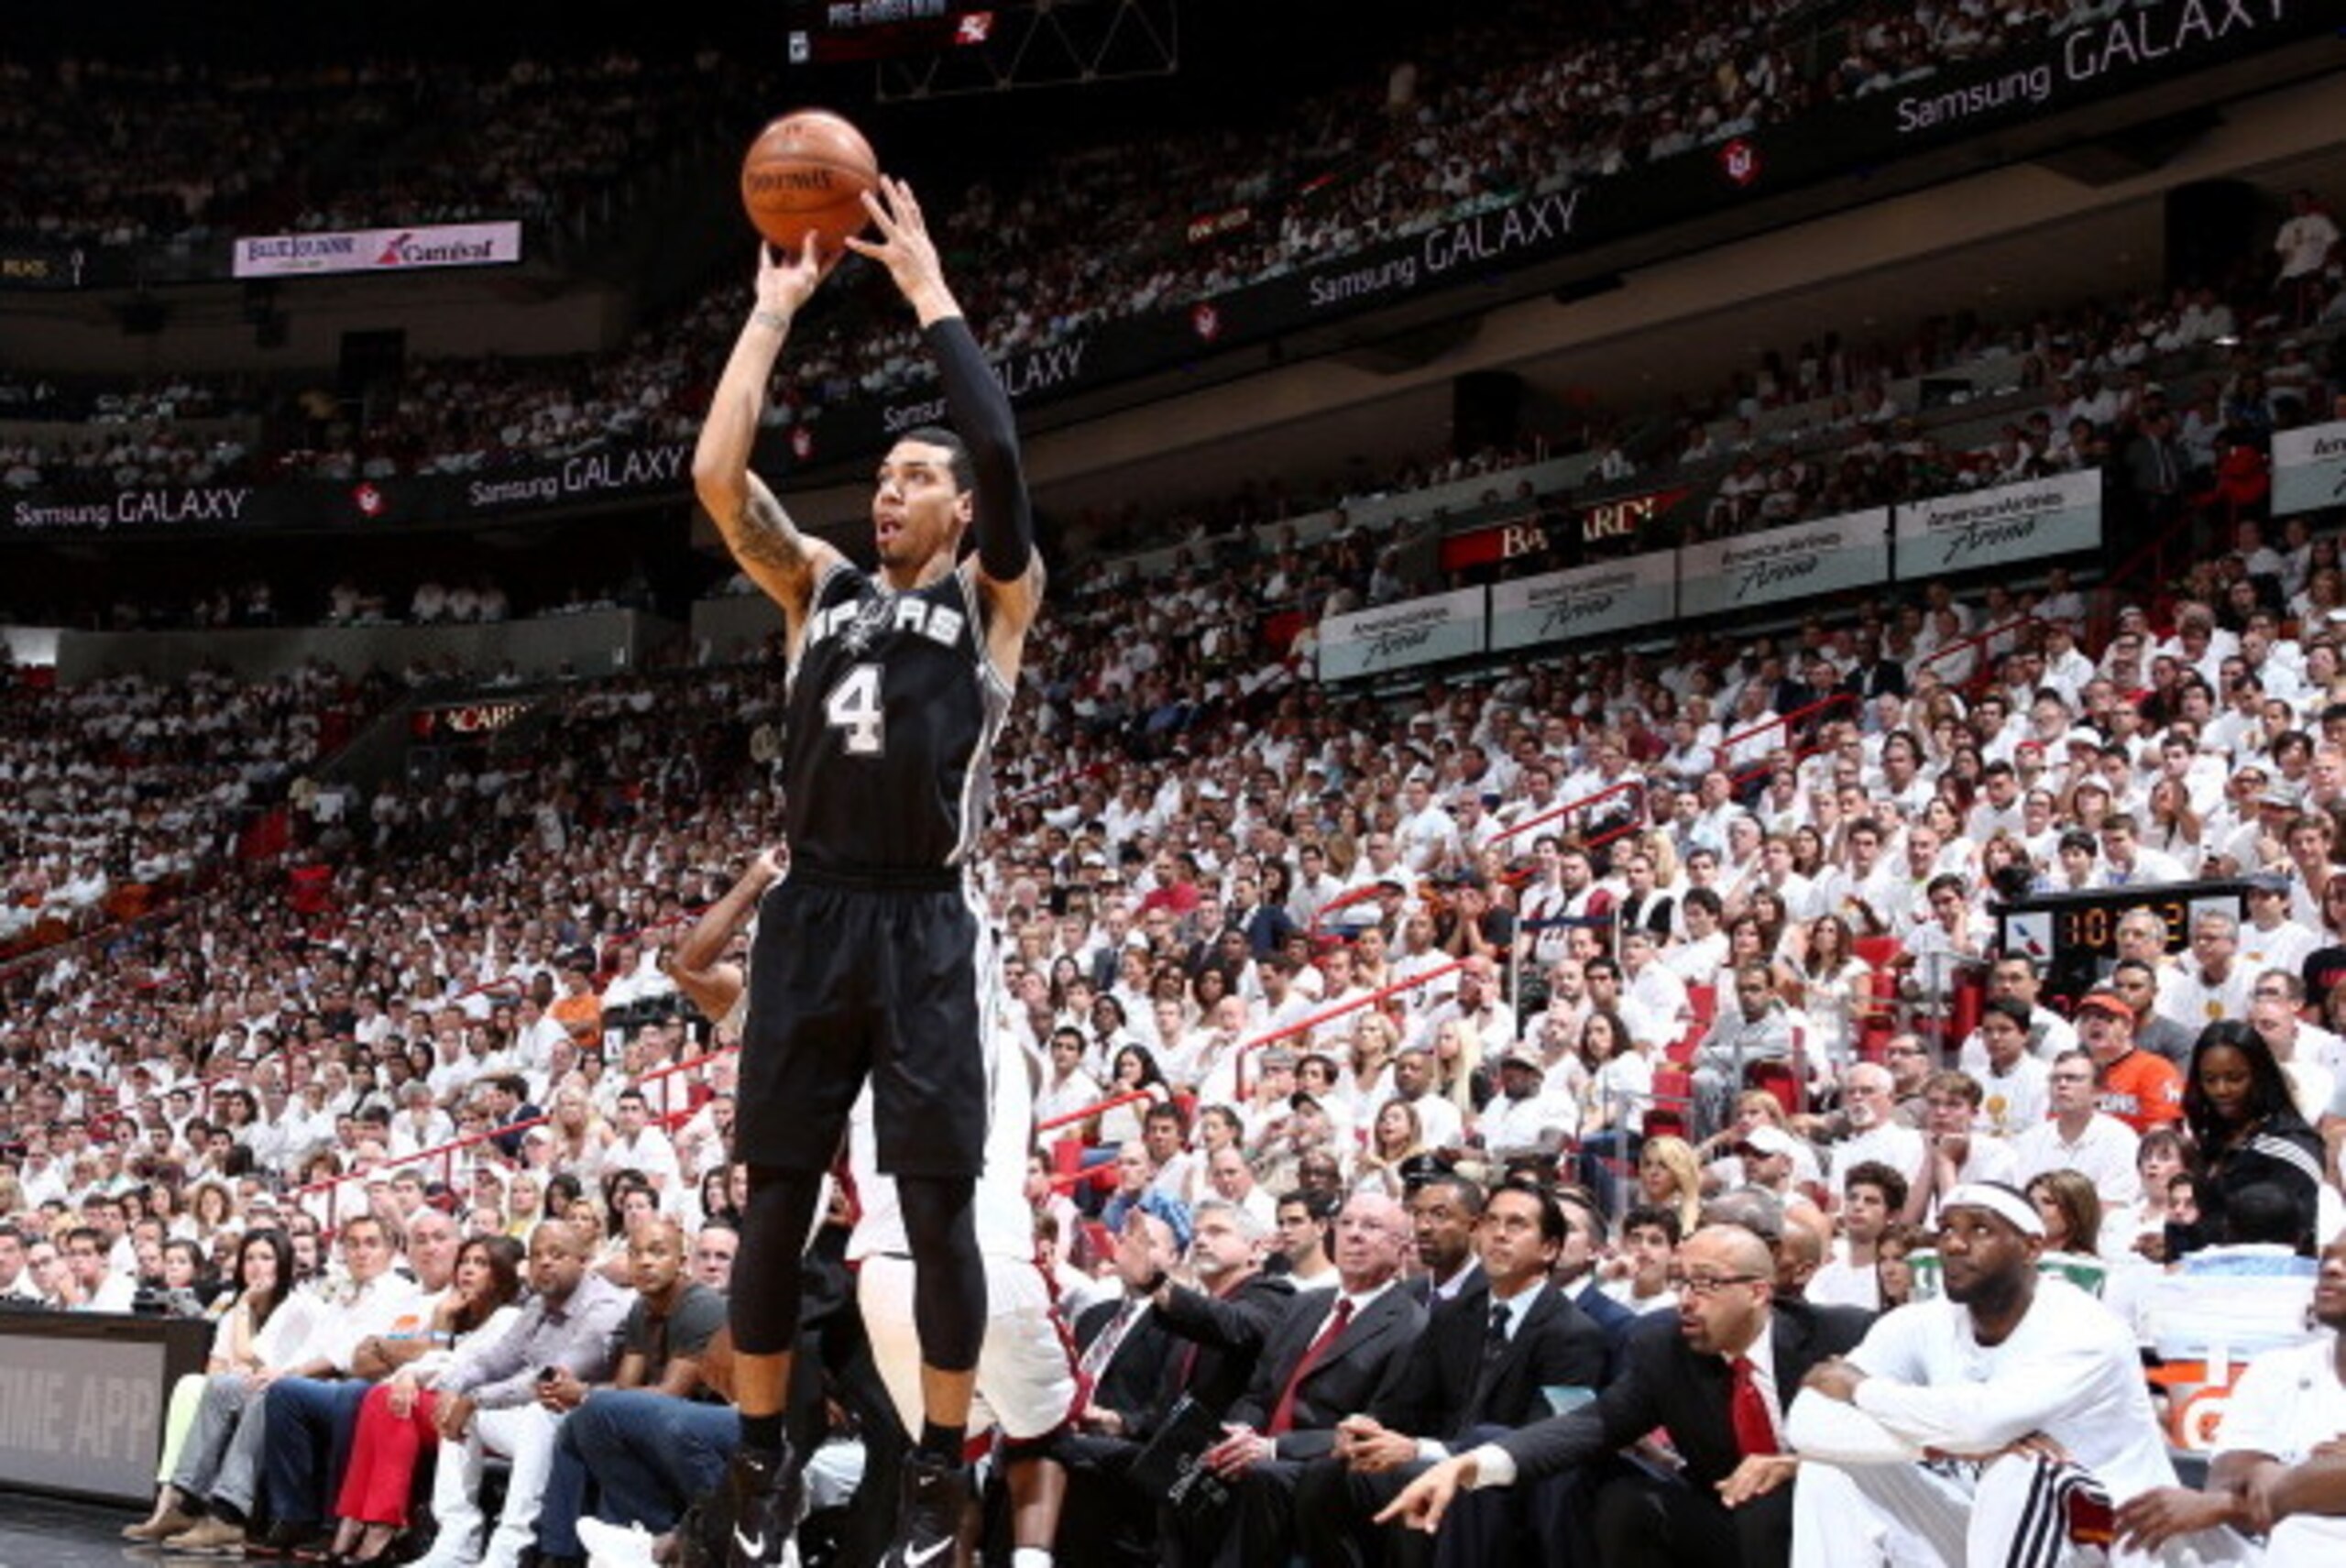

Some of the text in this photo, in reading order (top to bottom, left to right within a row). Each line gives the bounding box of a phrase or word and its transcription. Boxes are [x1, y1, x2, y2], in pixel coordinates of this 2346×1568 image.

[1897, 65, 2051, 132] Samsung
[1310, 189, 1581, 305] Samsung GALAXY
[883, 398, 948, 433] Samsu
[15, 488, 247, 530] Samsung GALAXY
[469, 445, 685, 506] Samsung GALAXY
[824, 663, 885, 757] 4
[73, 1374, 156, 1463] APP
